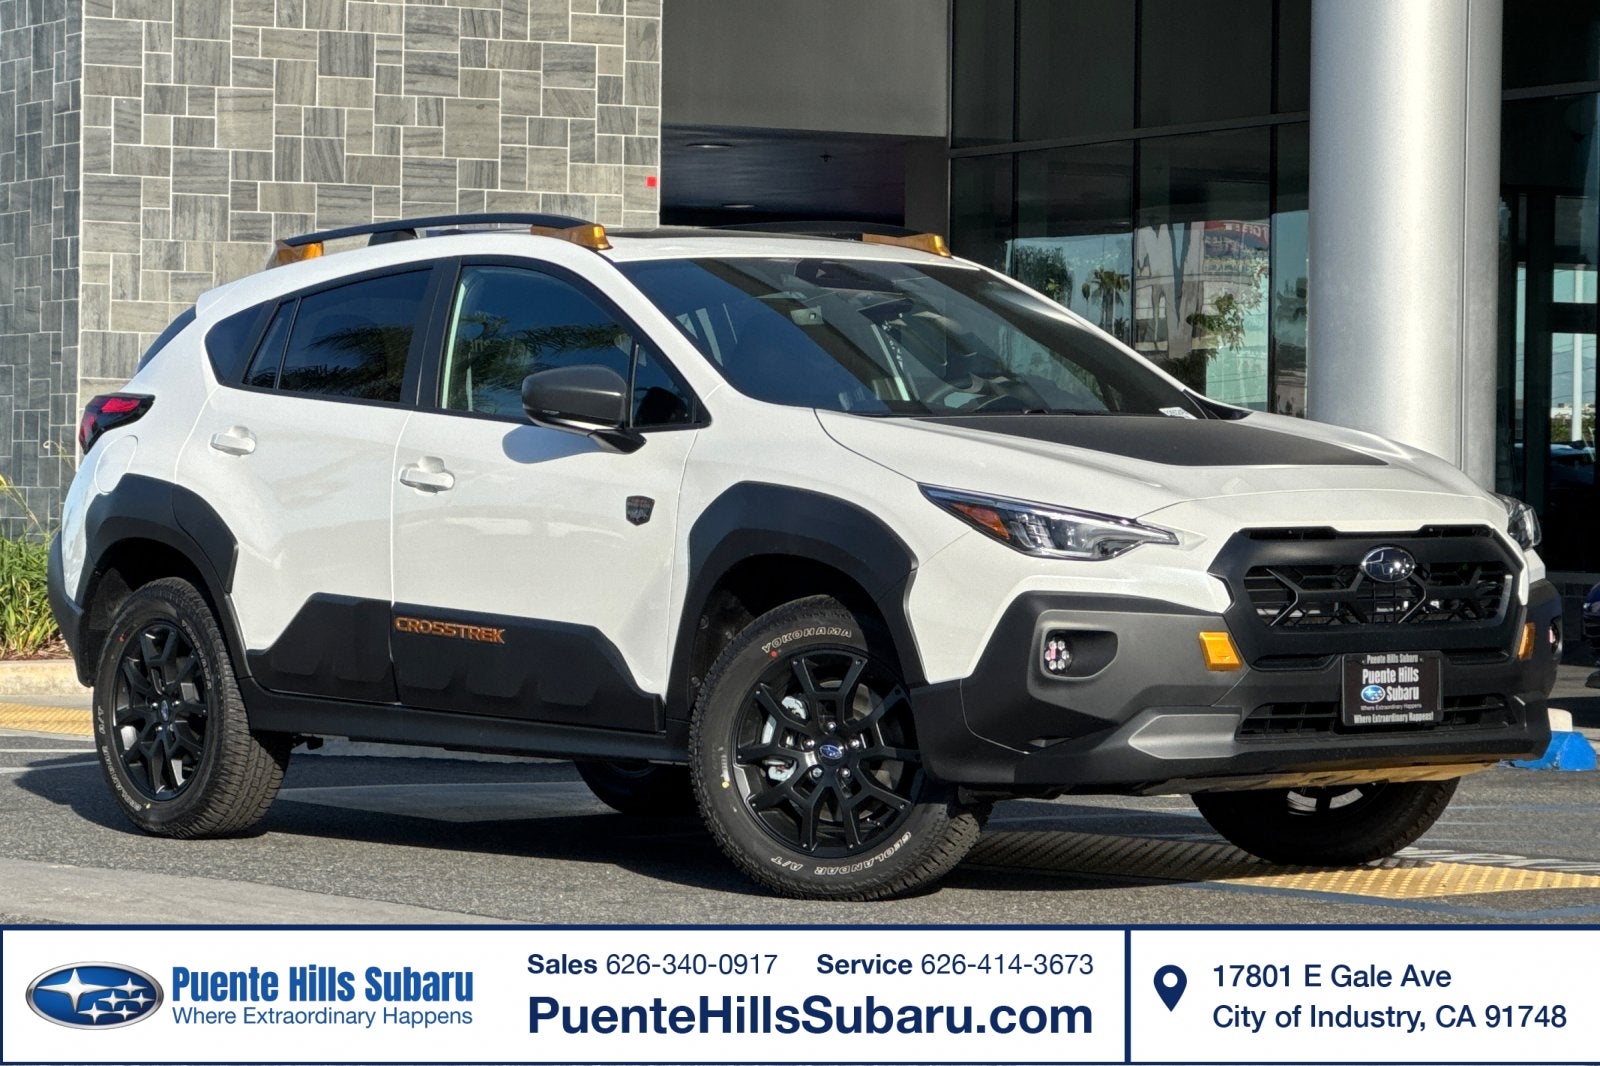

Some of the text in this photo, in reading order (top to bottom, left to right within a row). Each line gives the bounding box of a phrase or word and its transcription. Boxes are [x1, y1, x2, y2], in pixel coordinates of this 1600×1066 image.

[394, 616, 506, 645] CROSSTREK
[761, 626, 852, 654] YOKOHAMA
[1366, 653, 1419, 665] Puente Hills Subaru
[1362, 666, 1420, 685] Puente Hills
[1386, 685, 1420, 702] Subaru
[1353, 714, 1372, 724] Where
[1372, 712, 1408, 723] Extraordinary
[770, 831, 912, 876] GEOLANDAR A/T
